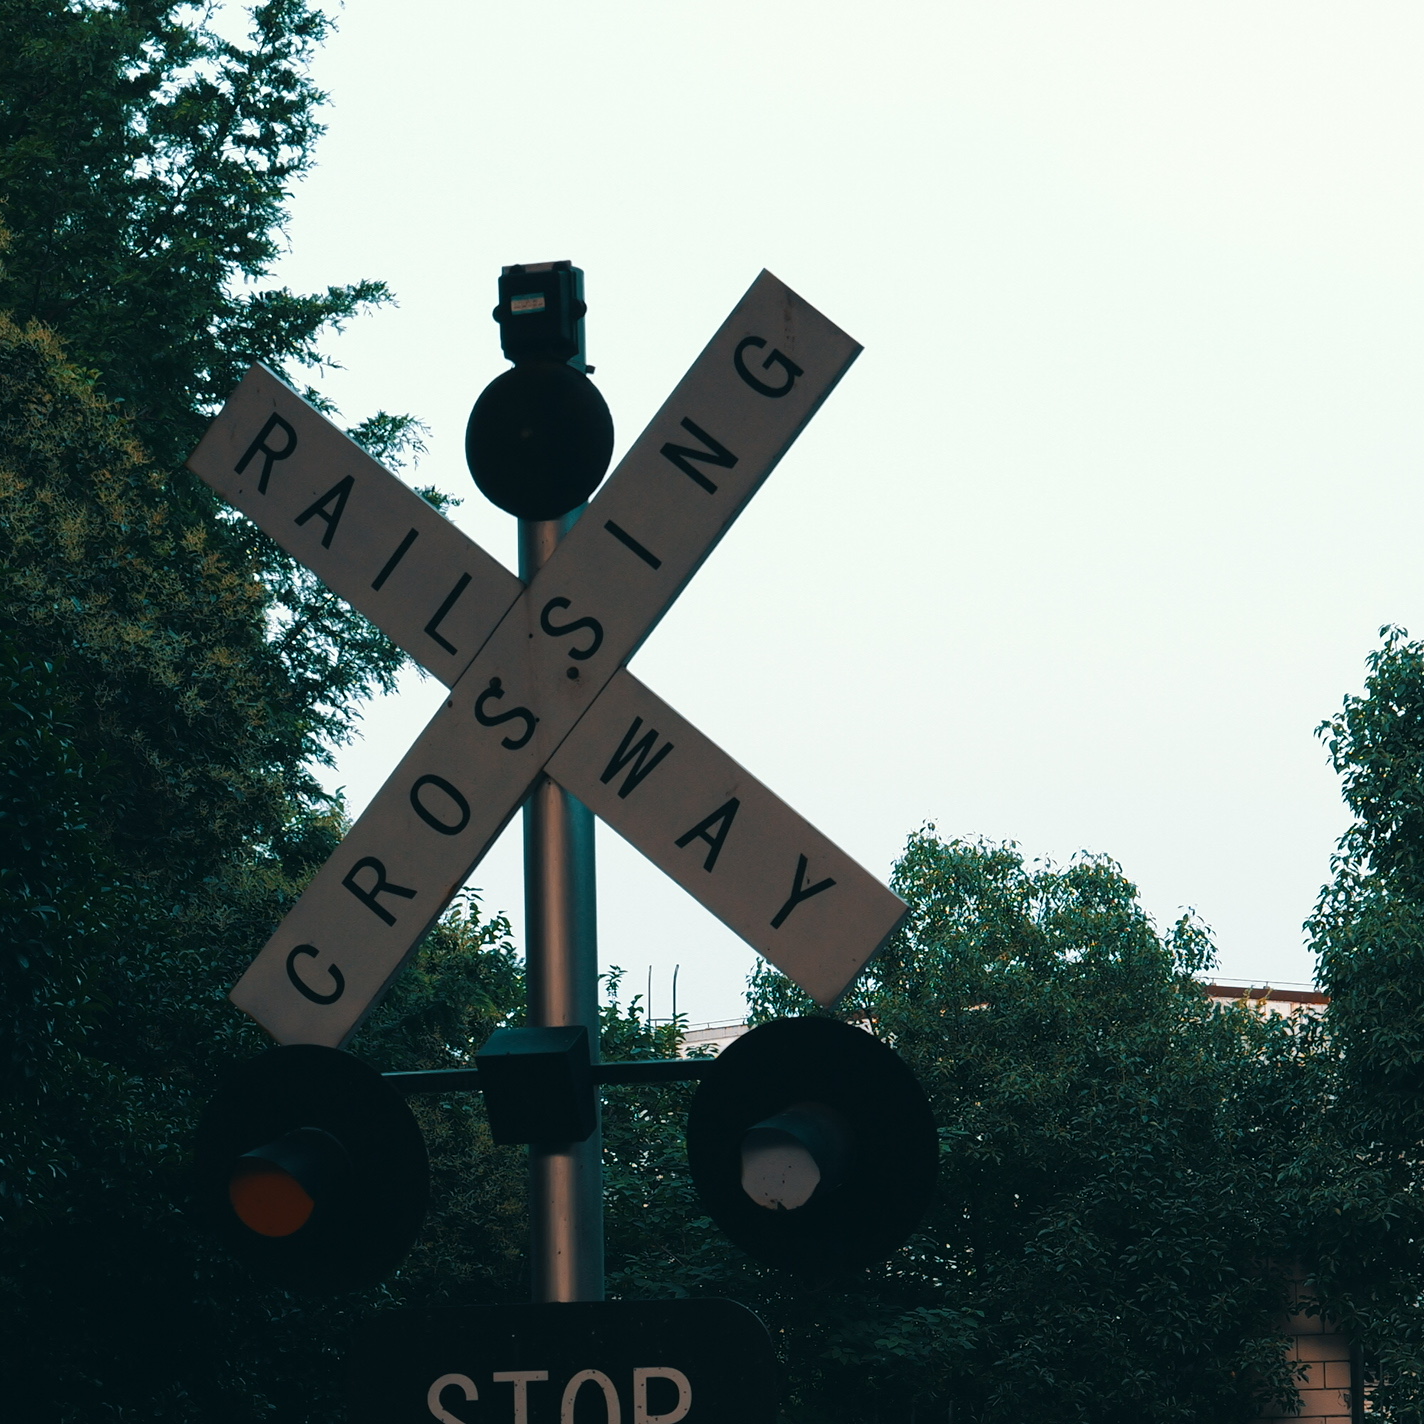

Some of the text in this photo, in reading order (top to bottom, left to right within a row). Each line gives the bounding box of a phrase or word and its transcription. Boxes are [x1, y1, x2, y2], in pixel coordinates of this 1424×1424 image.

[233, 411, 837, 930] RAIL WAY
[285, 335, 805, 1006] CROSSING
